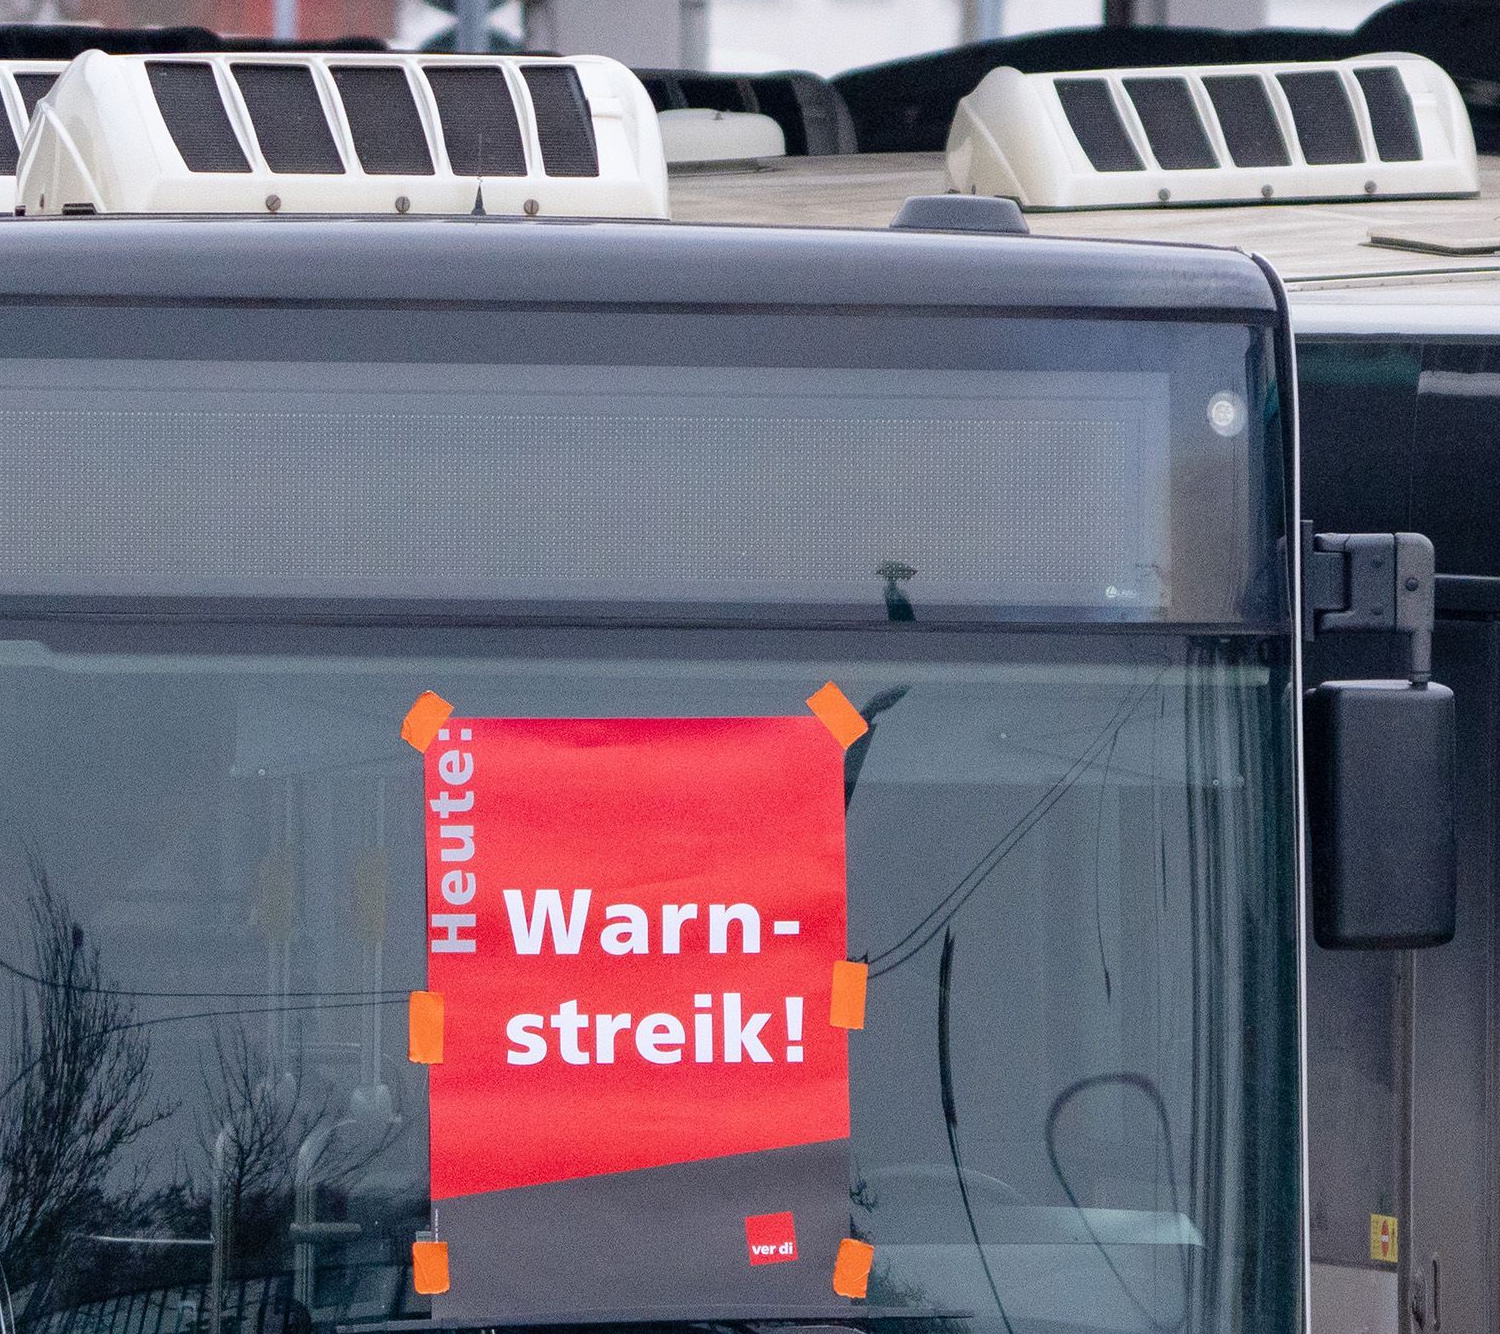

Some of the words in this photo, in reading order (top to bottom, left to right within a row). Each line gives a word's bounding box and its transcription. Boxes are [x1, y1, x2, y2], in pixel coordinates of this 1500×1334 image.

[430, 728, 477, 954] Heute:
[502, 888, 801, 956] Warn-
[506, 992, 804, 1066] streik!
